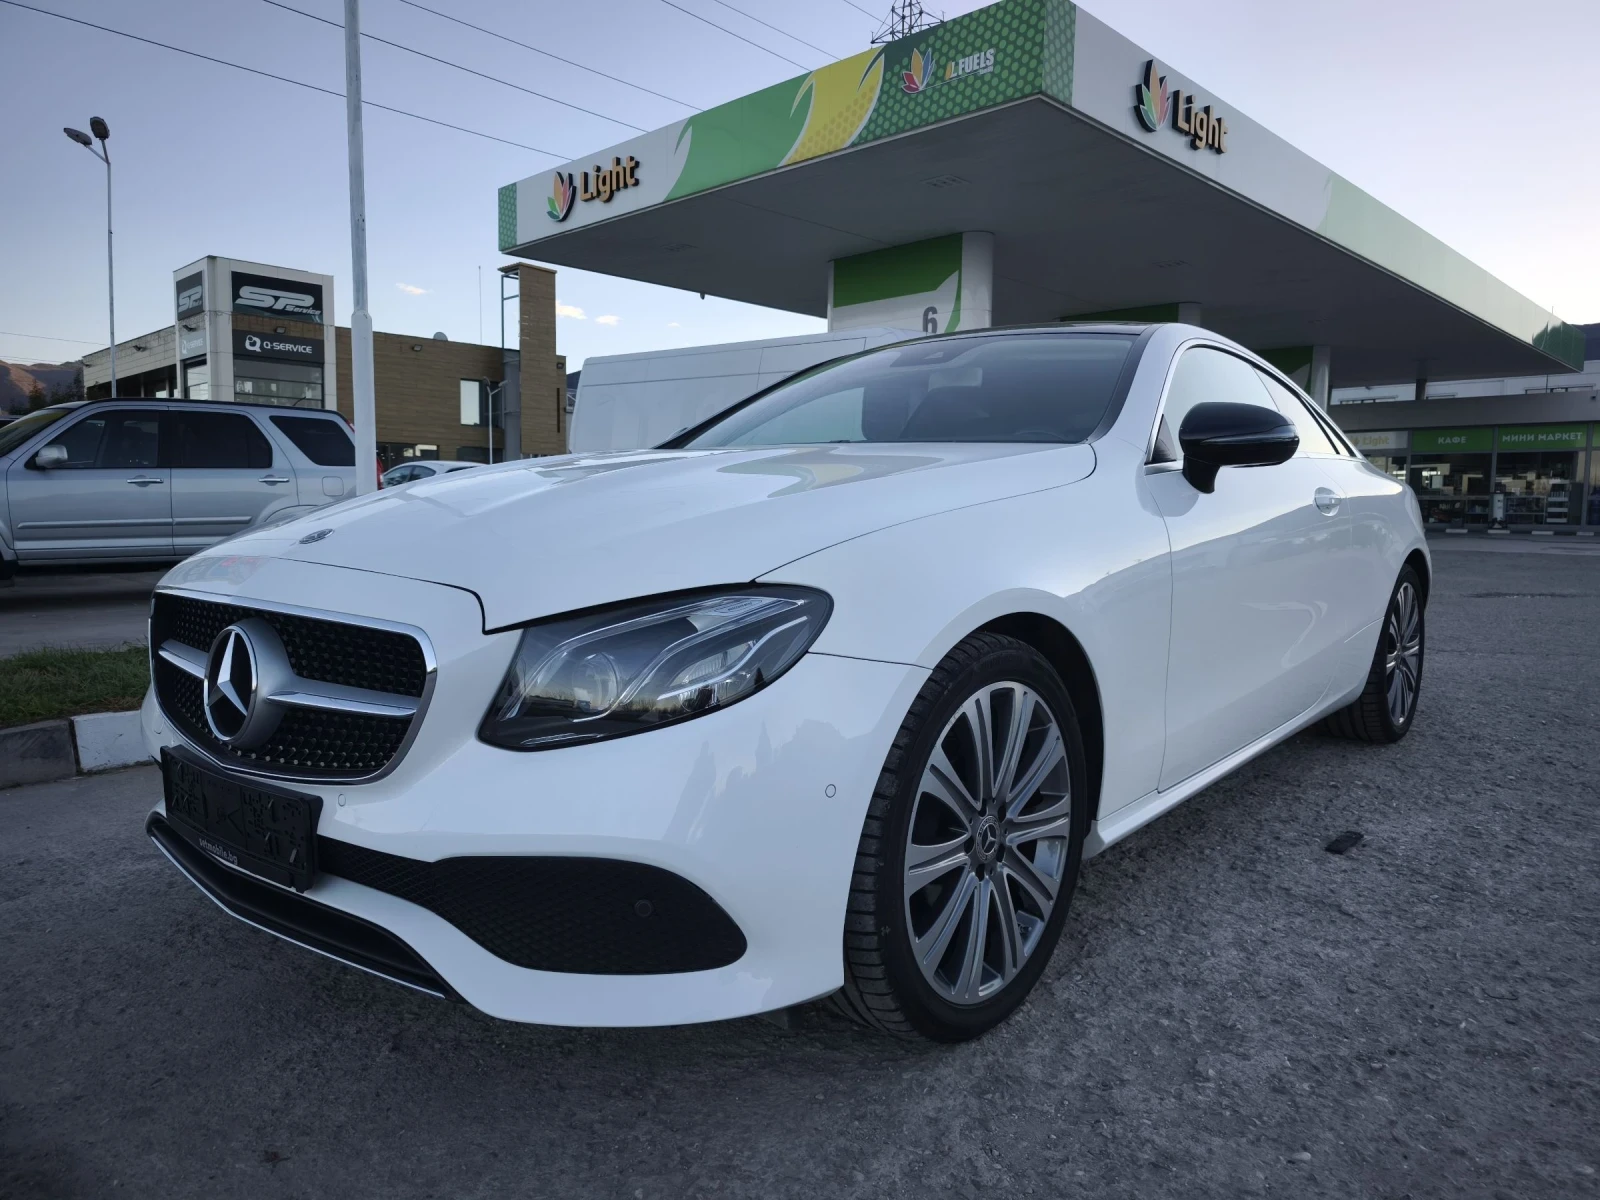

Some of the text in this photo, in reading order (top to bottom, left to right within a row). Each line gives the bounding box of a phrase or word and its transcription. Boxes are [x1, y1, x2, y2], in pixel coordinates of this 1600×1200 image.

[958, 48, 995, 75] FUELS
[1172, 89, 1228, 154] Light
[580, 155, 639, 203] Light
[234, 285, 315, 310] SP
[284, 304, 321, 316] Service
[922, 306, 938, 334] 6
[263, 341, 313, 354] Q-SERVICE
[1362, 435, 1390, 447] Light
[1437, 436, 1467, 445] КАФЕ
[1502, 431, 1583, 442] МИНИ МАРКЕТ
